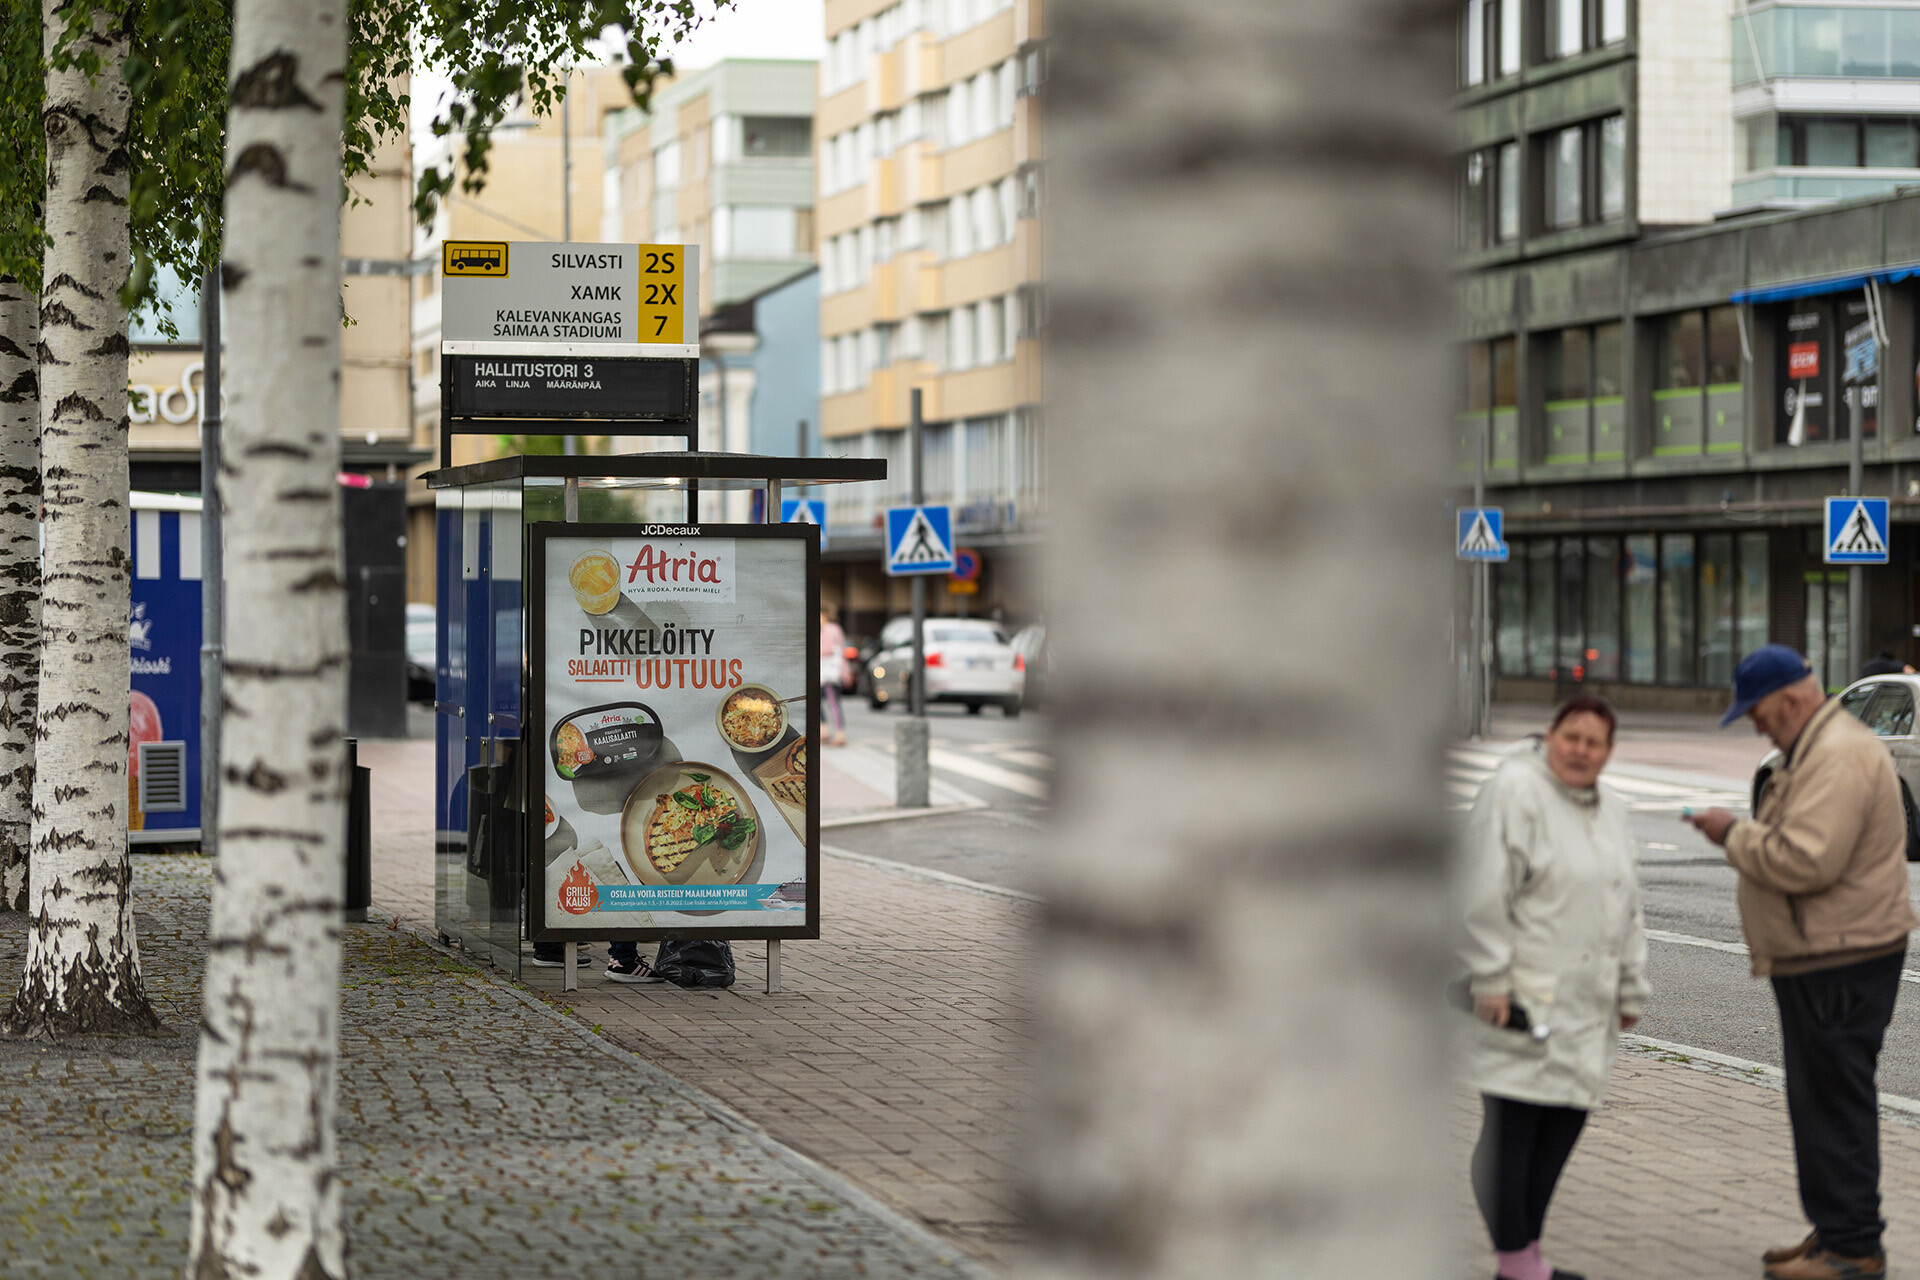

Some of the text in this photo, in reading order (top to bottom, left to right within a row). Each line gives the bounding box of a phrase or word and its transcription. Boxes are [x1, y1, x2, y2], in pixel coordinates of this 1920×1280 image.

[551, 252, 675, 274] SILVASTI 2S
[571, 284, 677, 305] XAMK 2X
[496, 310, 668, 336] KALEVANKANGAS 7
[493, 324, 622, 338] SAIMAA STADIUMI
[475, 363, 593, 378] HALLITUSTORI 3
[475, 380, 601, 389] AIKA LINJA MÄÄRÄNPÄÄ
[641, 525, 700, 535] JCDecaux
[626, 544, 721, 584] Atria
[580, 623, 715, 655] PIKKELÖITY
[568, 659, 743, 689] SALAATTI UUTUUS
[601, 715, 621, 724] Atria
[593, 731, 637, 745] KAALISALAATTI
[566, 886, 593, 897] GRILLI-
[610, 890, 627, 898] OSTA
[628, 890, 635, 898] JA
[637, 890, 656, 898] VOITA
[657, 890, 683, 898] RISTEILY
[722, 889, 747, 897] YMPÄRI
[566, 897, 590, 907] KAUSI
